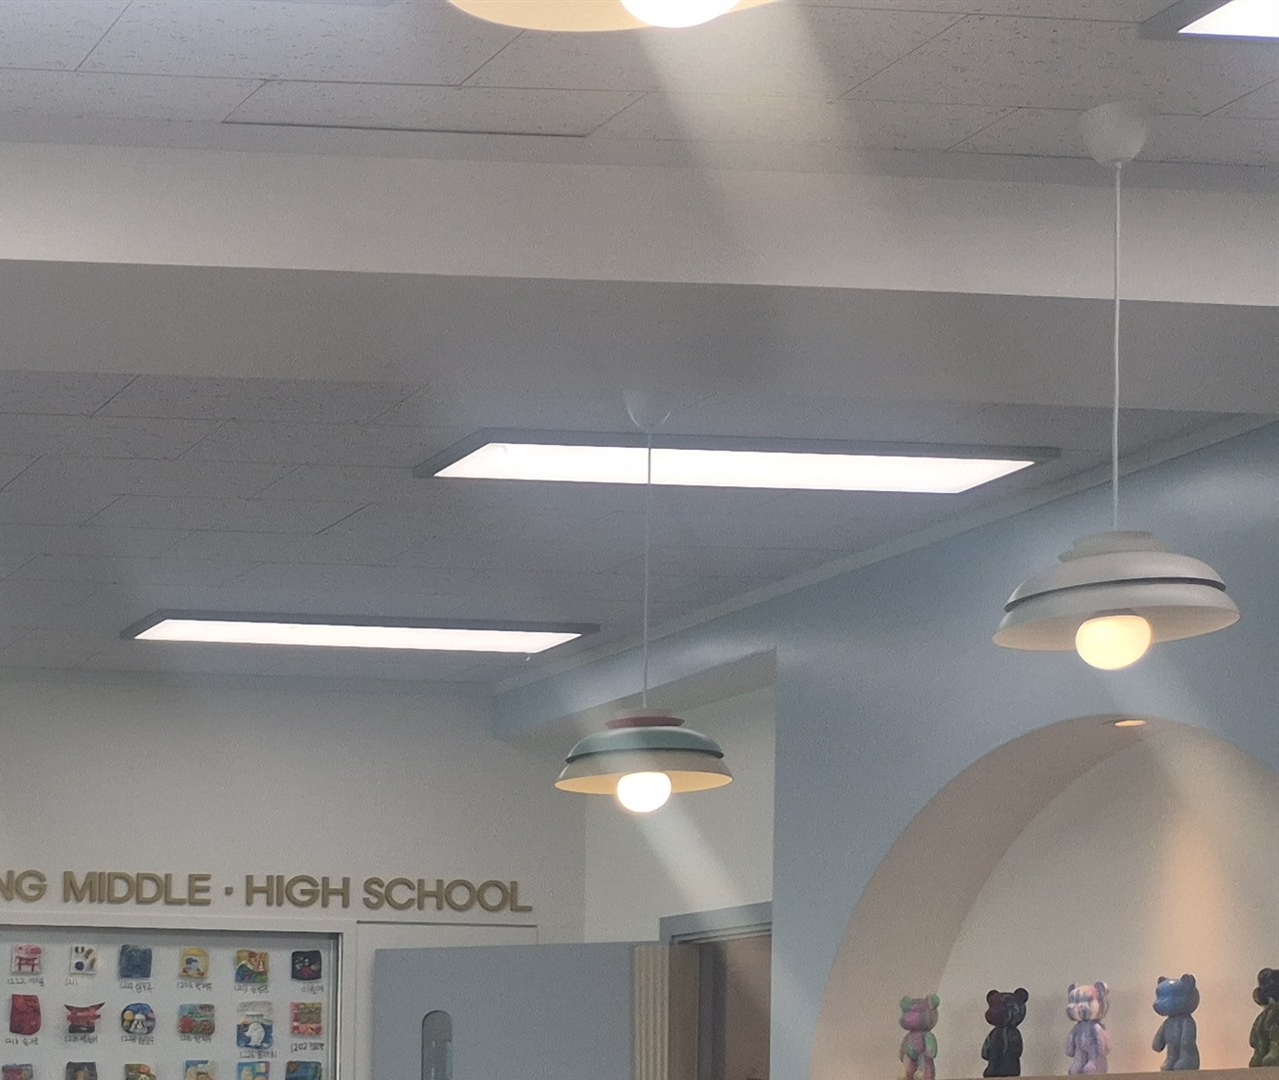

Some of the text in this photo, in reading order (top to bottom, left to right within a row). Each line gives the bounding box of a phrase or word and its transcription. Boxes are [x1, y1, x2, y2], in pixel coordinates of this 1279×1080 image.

[62, 870, 212, 908] MIDDLE
[245, 874, 351, 909] HIGH
[362, 876, 534, 913] SCHOOL
